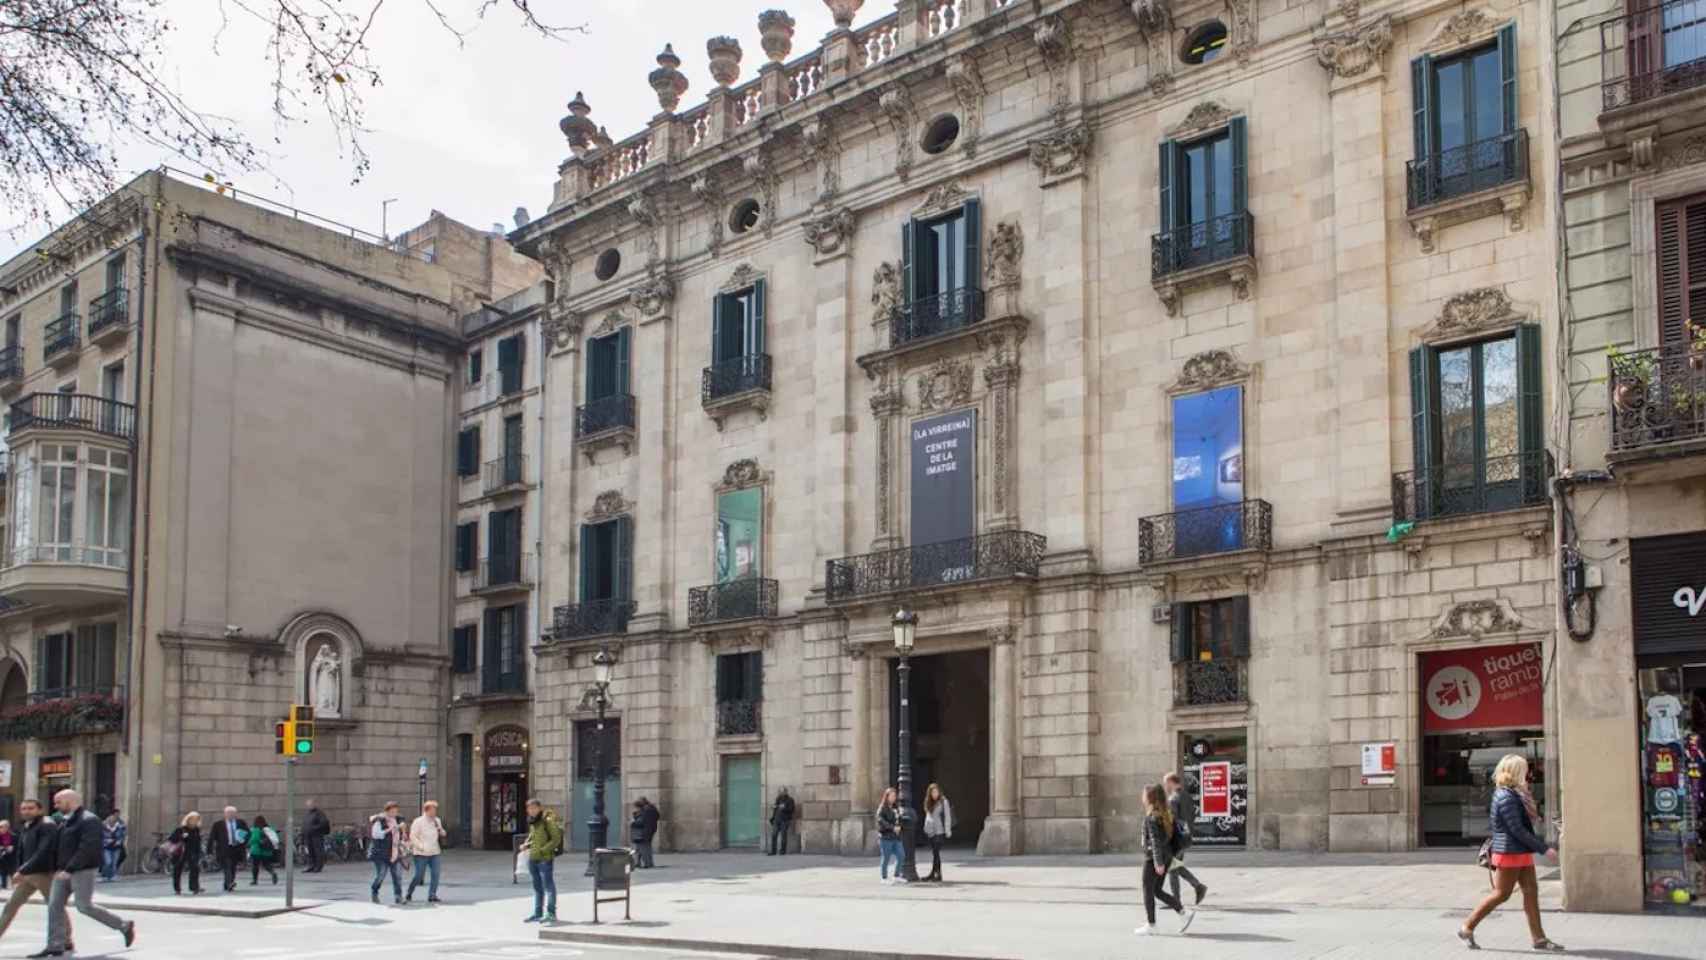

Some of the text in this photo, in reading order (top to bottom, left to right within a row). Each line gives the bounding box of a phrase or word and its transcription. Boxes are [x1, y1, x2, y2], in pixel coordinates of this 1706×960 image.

[925, 438, 958, 454] CENTRE
[930, 450, 953, 464] DE LA
[925, 461, 957, 476] IMATGE
